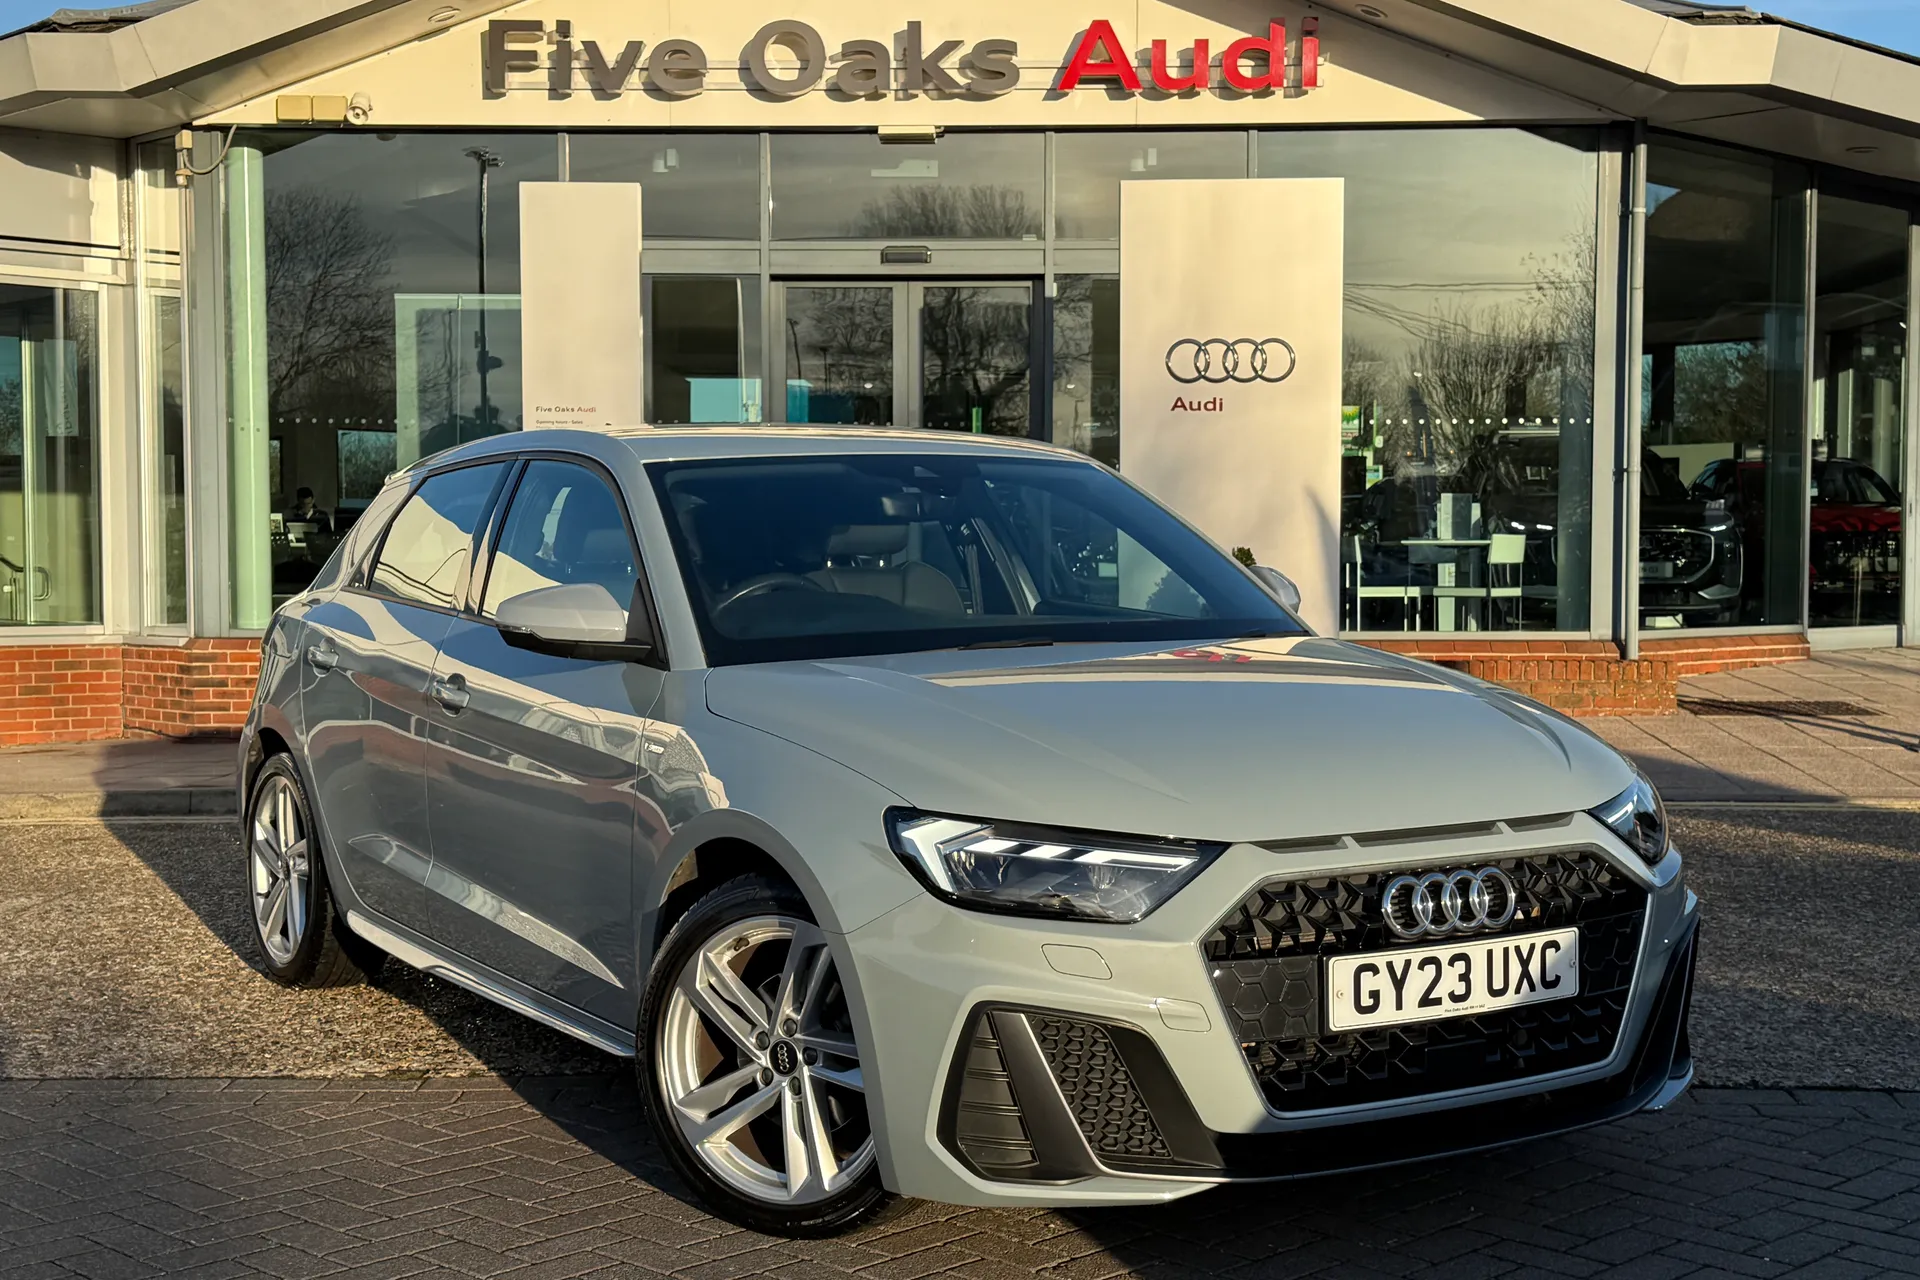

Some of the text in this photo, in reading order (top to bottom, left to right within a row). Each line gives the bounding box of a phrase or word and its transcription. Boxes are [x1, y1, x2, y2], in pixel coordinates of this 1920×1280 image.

[486, 17, 1319, 96] Five Oaks Audi
[1170, 396, 1224, 412] Audi
[1353, 939, 1562, 1015] GY23 UXC
